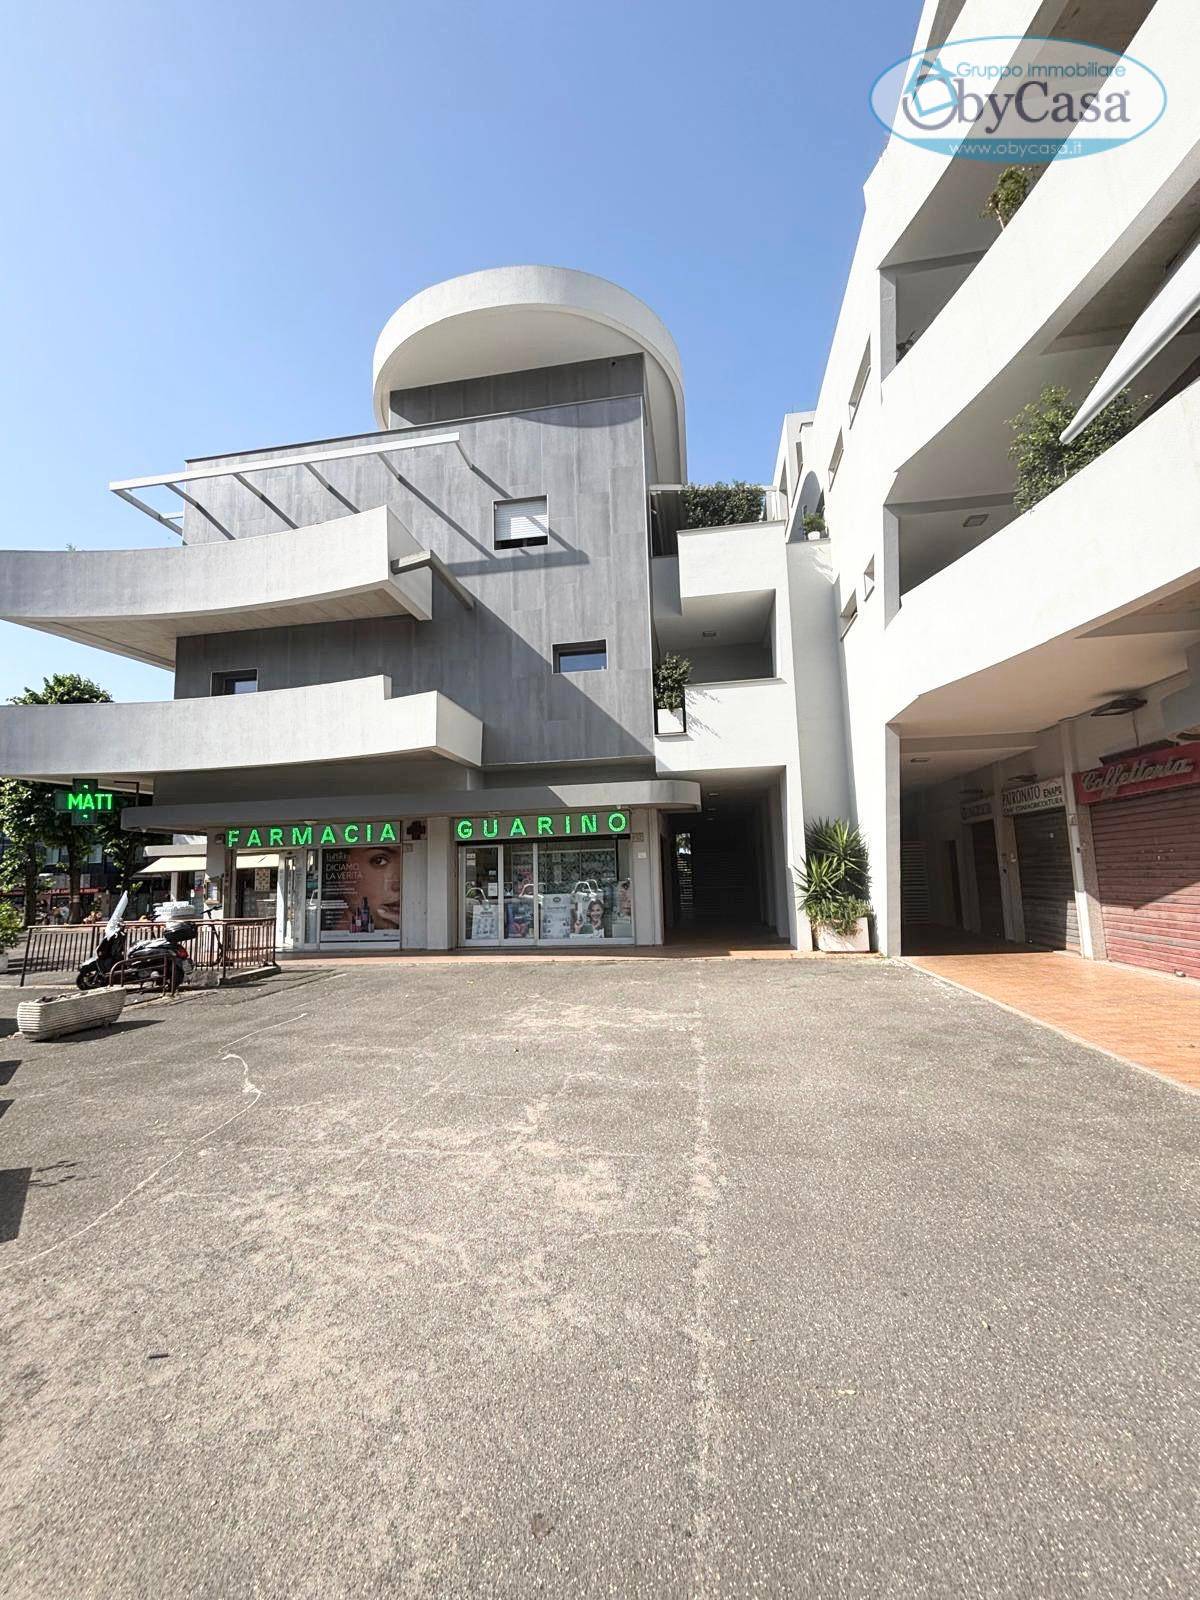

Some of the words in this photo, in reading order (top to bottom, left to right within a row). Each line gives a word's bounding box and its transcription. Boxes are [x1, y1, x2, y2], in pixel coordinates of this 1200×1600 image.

[68, 793, 113, 810] MATT
[1002, 785, 1041, 808] PATRONATO
[227, 823, 396, 847] FARMACIA
[457, 812, 626, 838] GUARINO
[325, 863, 360, 872] DICIAMO
[325, 872, 336, 880] LA
